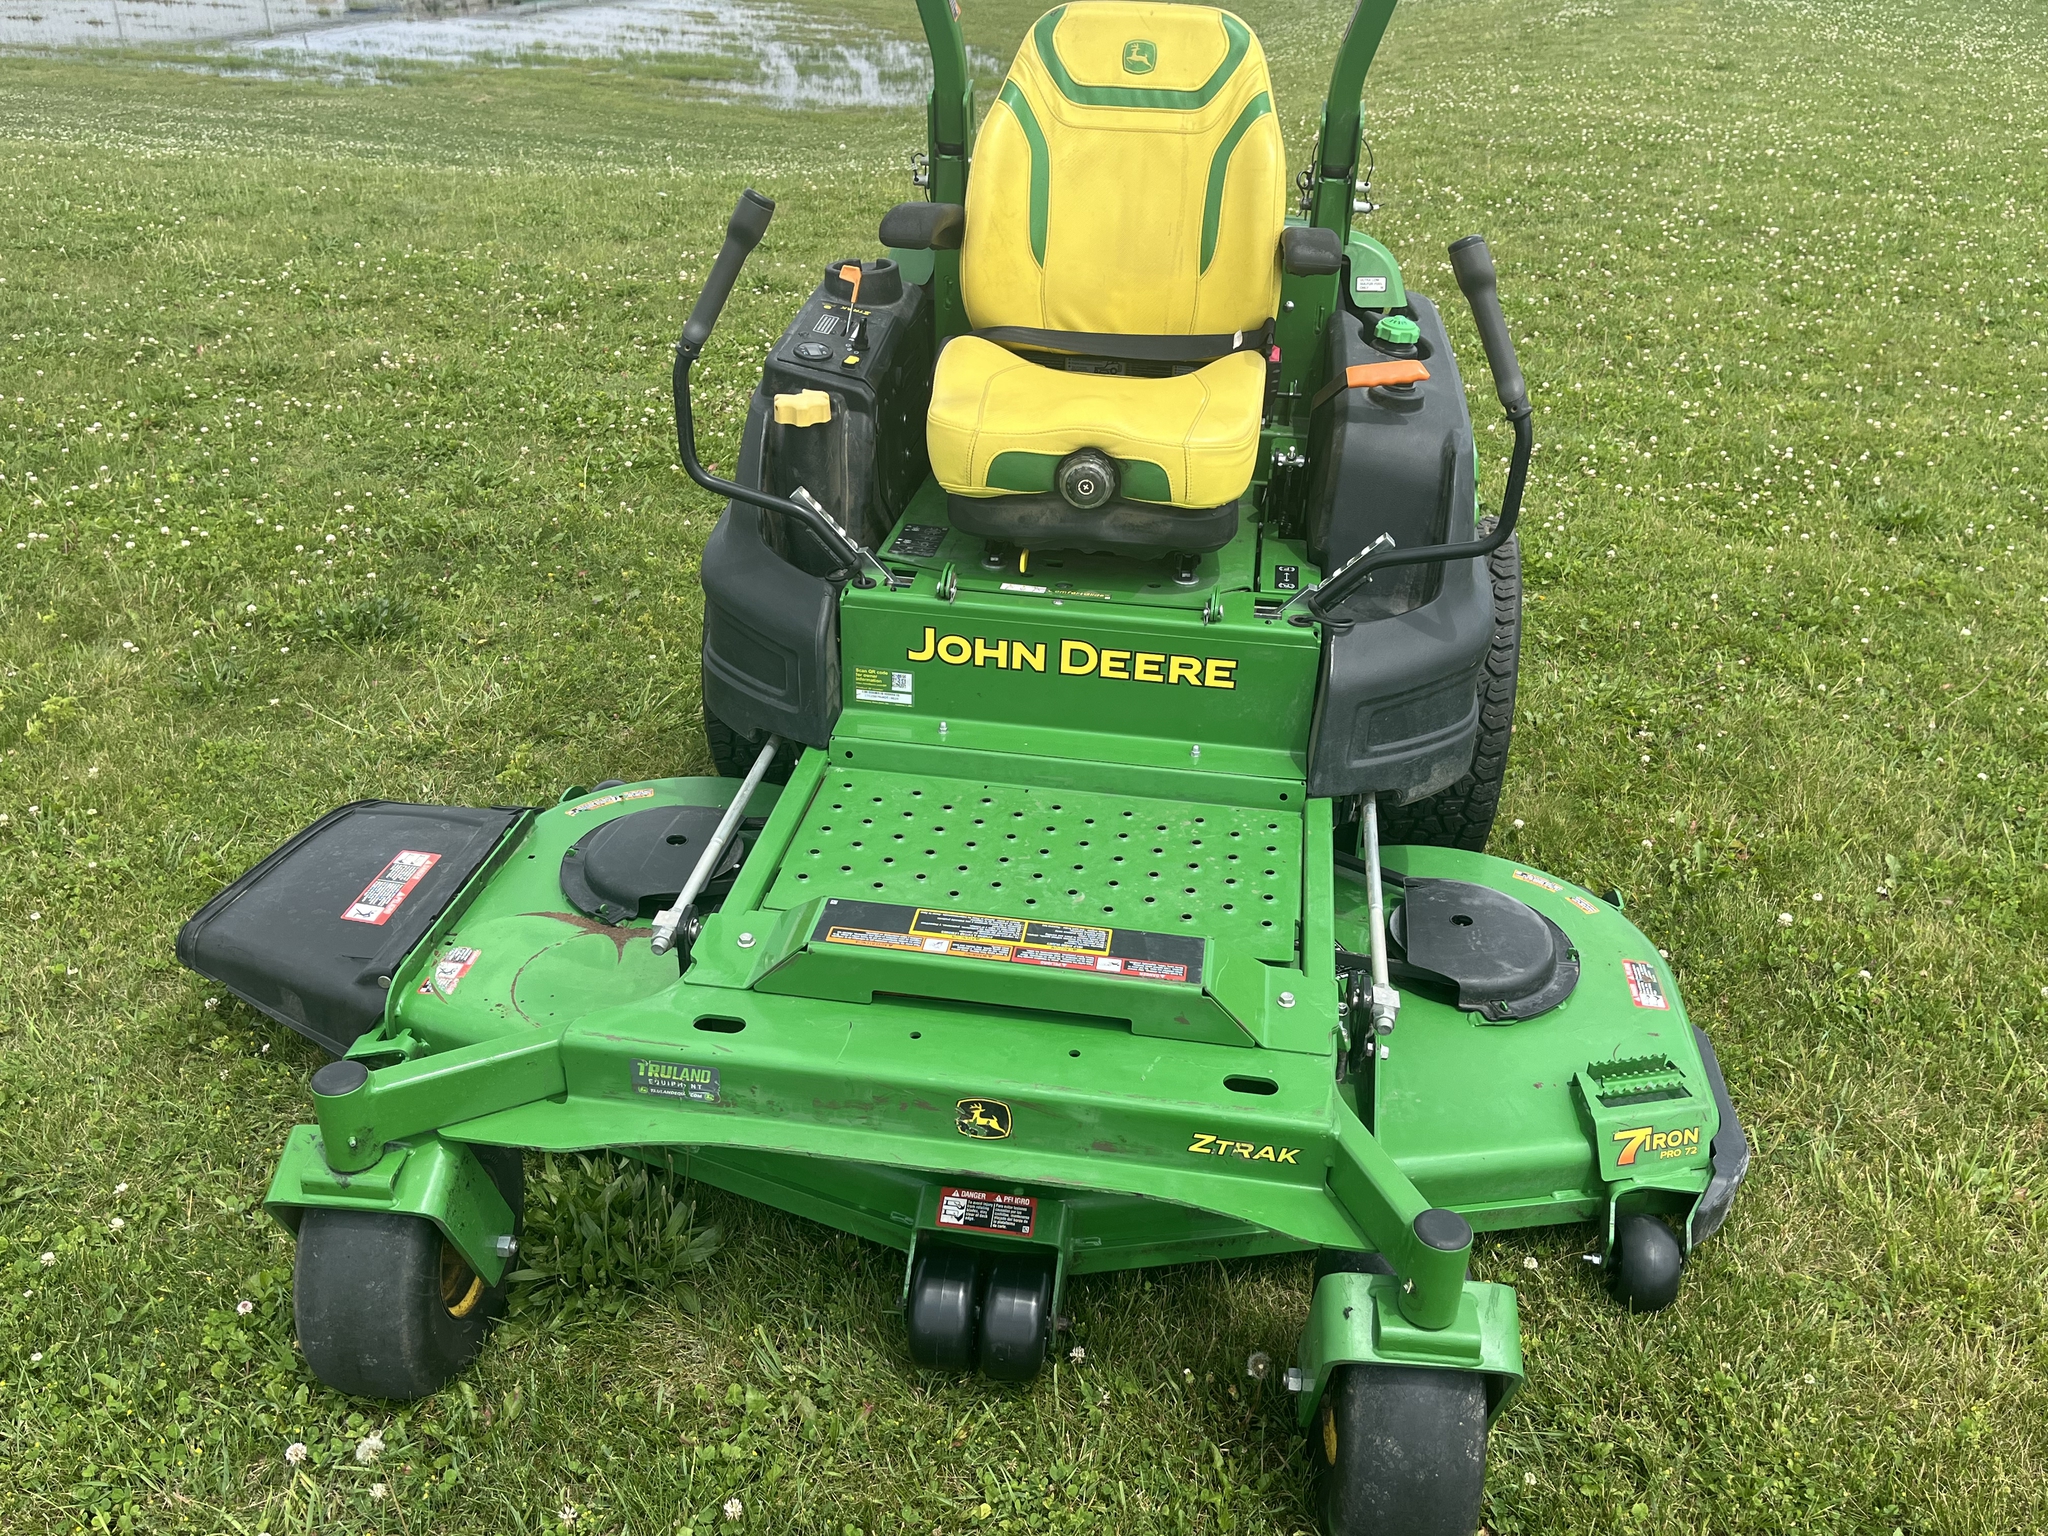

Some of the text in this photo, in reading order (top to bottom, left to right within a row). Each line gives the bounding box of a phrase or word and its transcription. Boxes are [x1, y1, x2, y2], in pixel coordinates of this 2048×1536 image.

[907, 626, 1238, 689] JOHN DEERE
[637, 1062, 712, 1084] TRULAND
[1188, 1132, 1305, 1164] ZTRAK
[1660, 1146, 1698, 1160] PRO 72
[961, 1190, 986, 1200] DANGER
